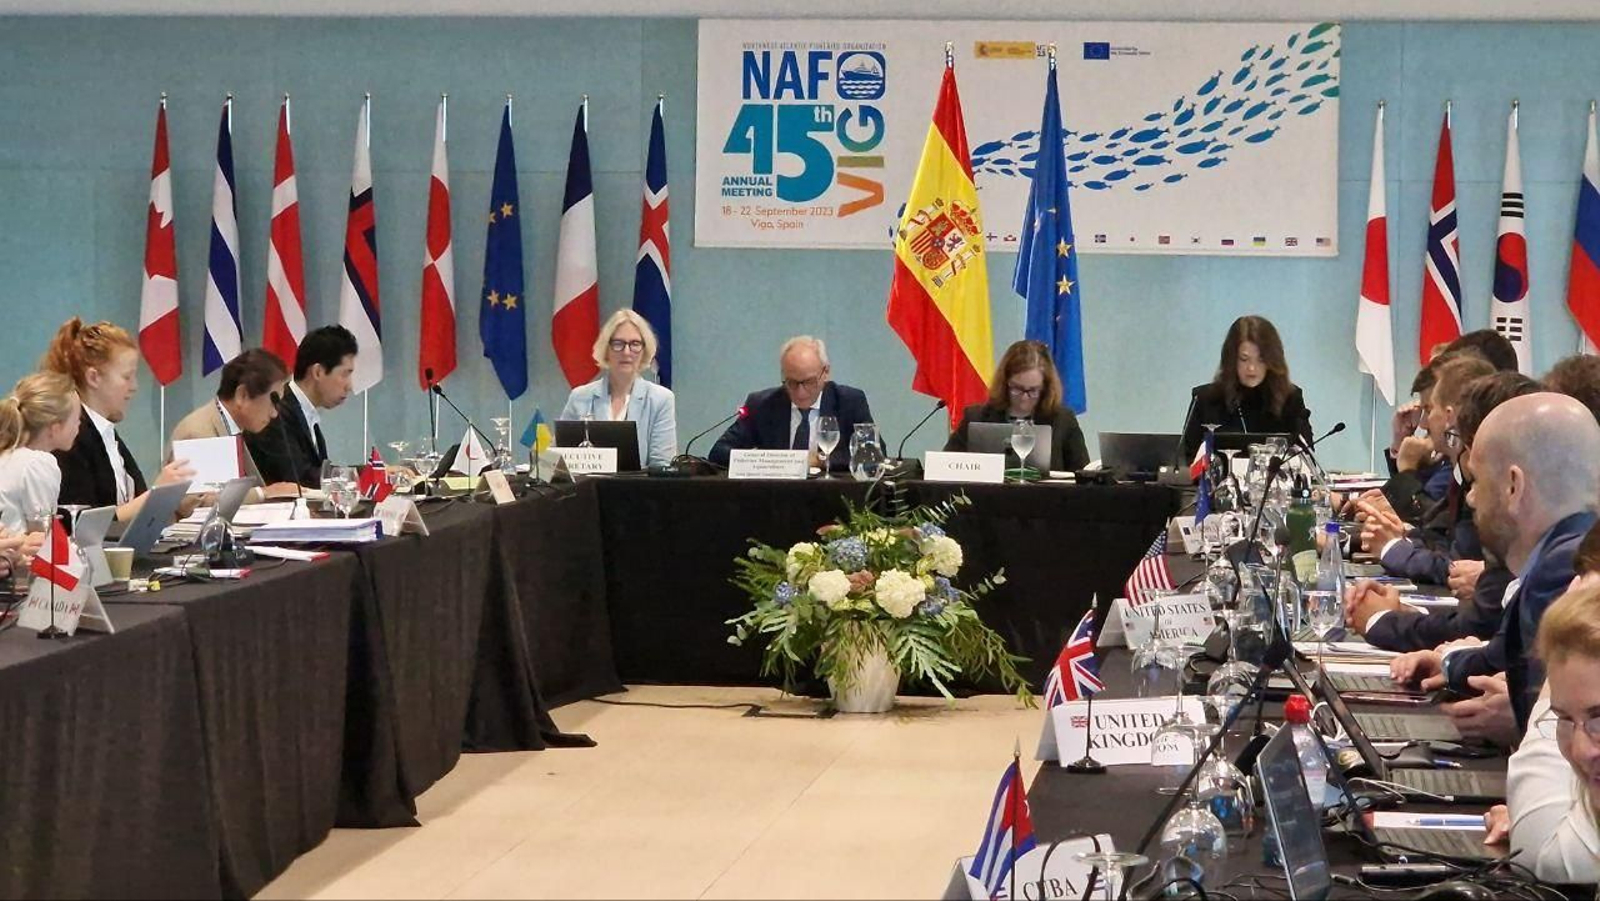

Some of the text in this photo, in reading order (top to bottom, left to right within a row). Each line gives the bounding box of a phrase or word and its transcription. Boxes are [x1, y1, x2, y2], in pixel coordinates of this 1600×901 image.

[836, 105, 886, 217] VIGO
[722, 176, 773, 186] ANNUAL
[721, 188, 773, 197] MEETING
[722, 206, 732, 216] 18
[740, 206, 751, 216] 22
[755, 206, 807, 217] September
[810, 206, 834, 216] 2023
[777, 219, 804, 230] Spain
[568, 462, 603, 470] RETARY
[947, 462, 981, 470] CHAIR
[1167, 603, 1206, 615] STATES
[1095, 713, 1166, 730] UNITED
